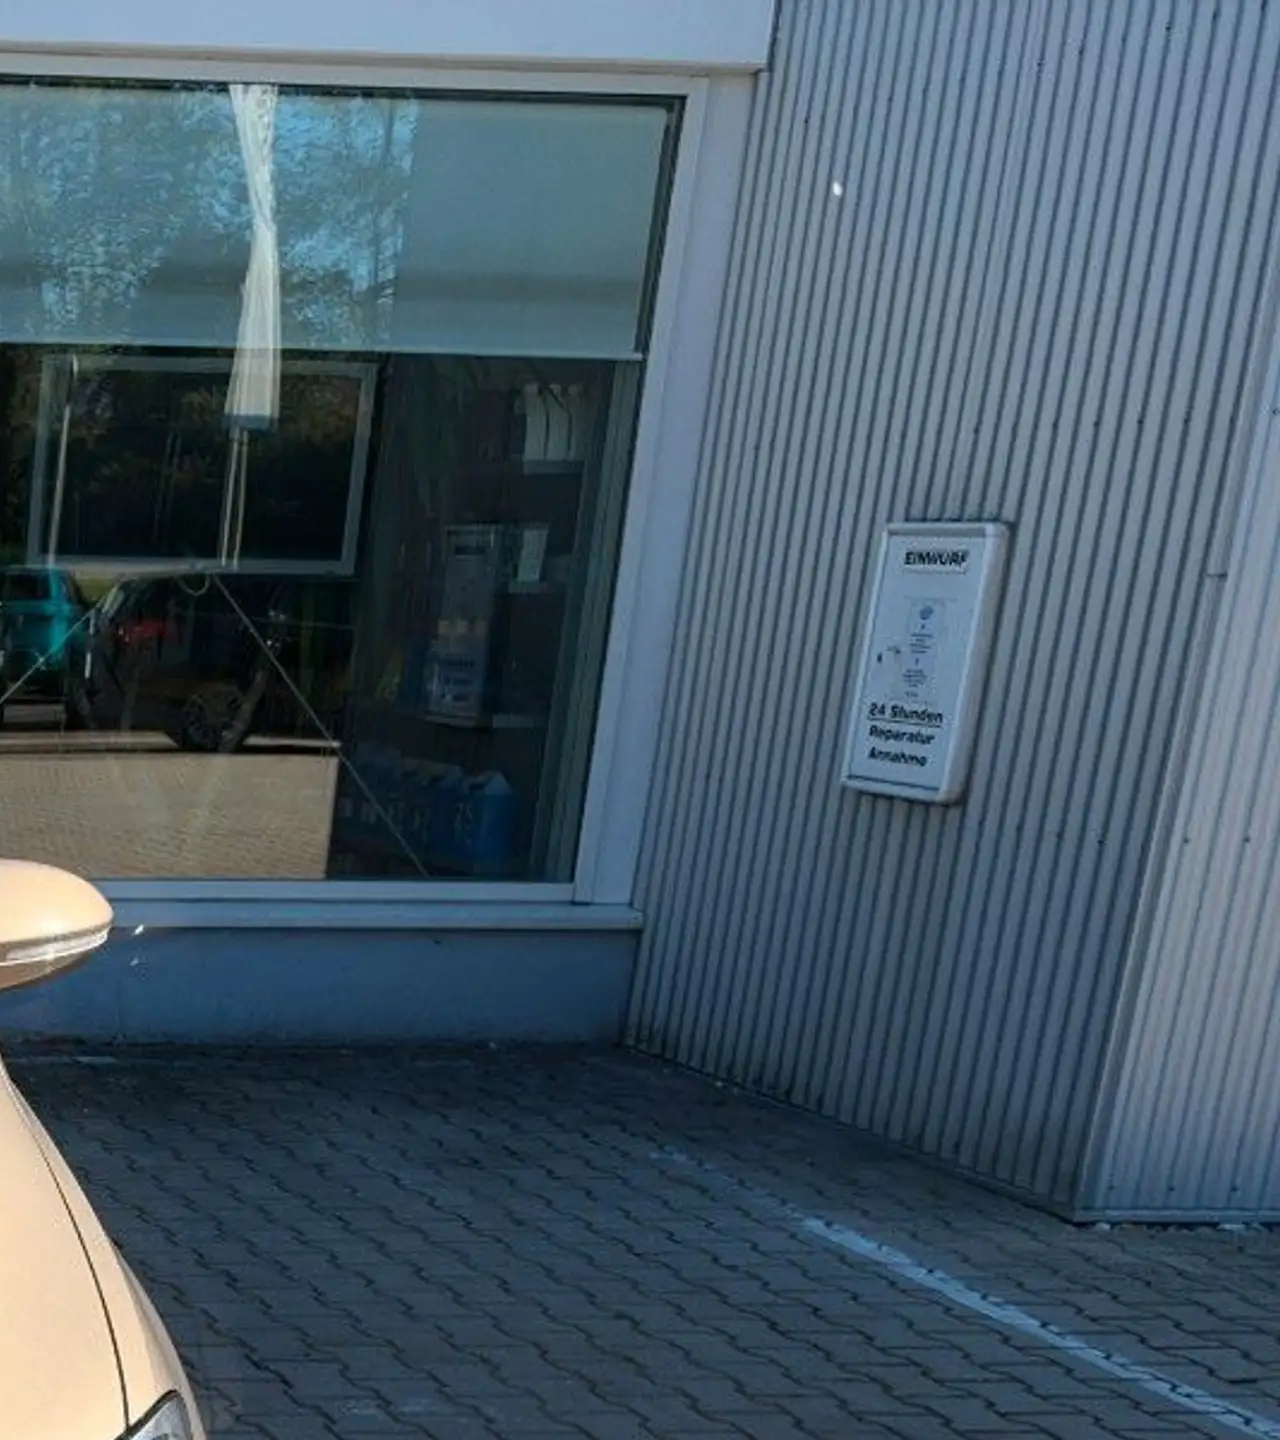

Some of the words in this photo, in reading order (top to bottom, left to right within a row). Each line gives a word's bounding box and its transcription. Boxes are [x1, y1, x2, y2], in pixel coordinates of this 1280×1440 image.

[869, 702, 885, 716] 24
[891, 705, 943, 723] Stunden
[869, 725, 935, 745] Reparatur
